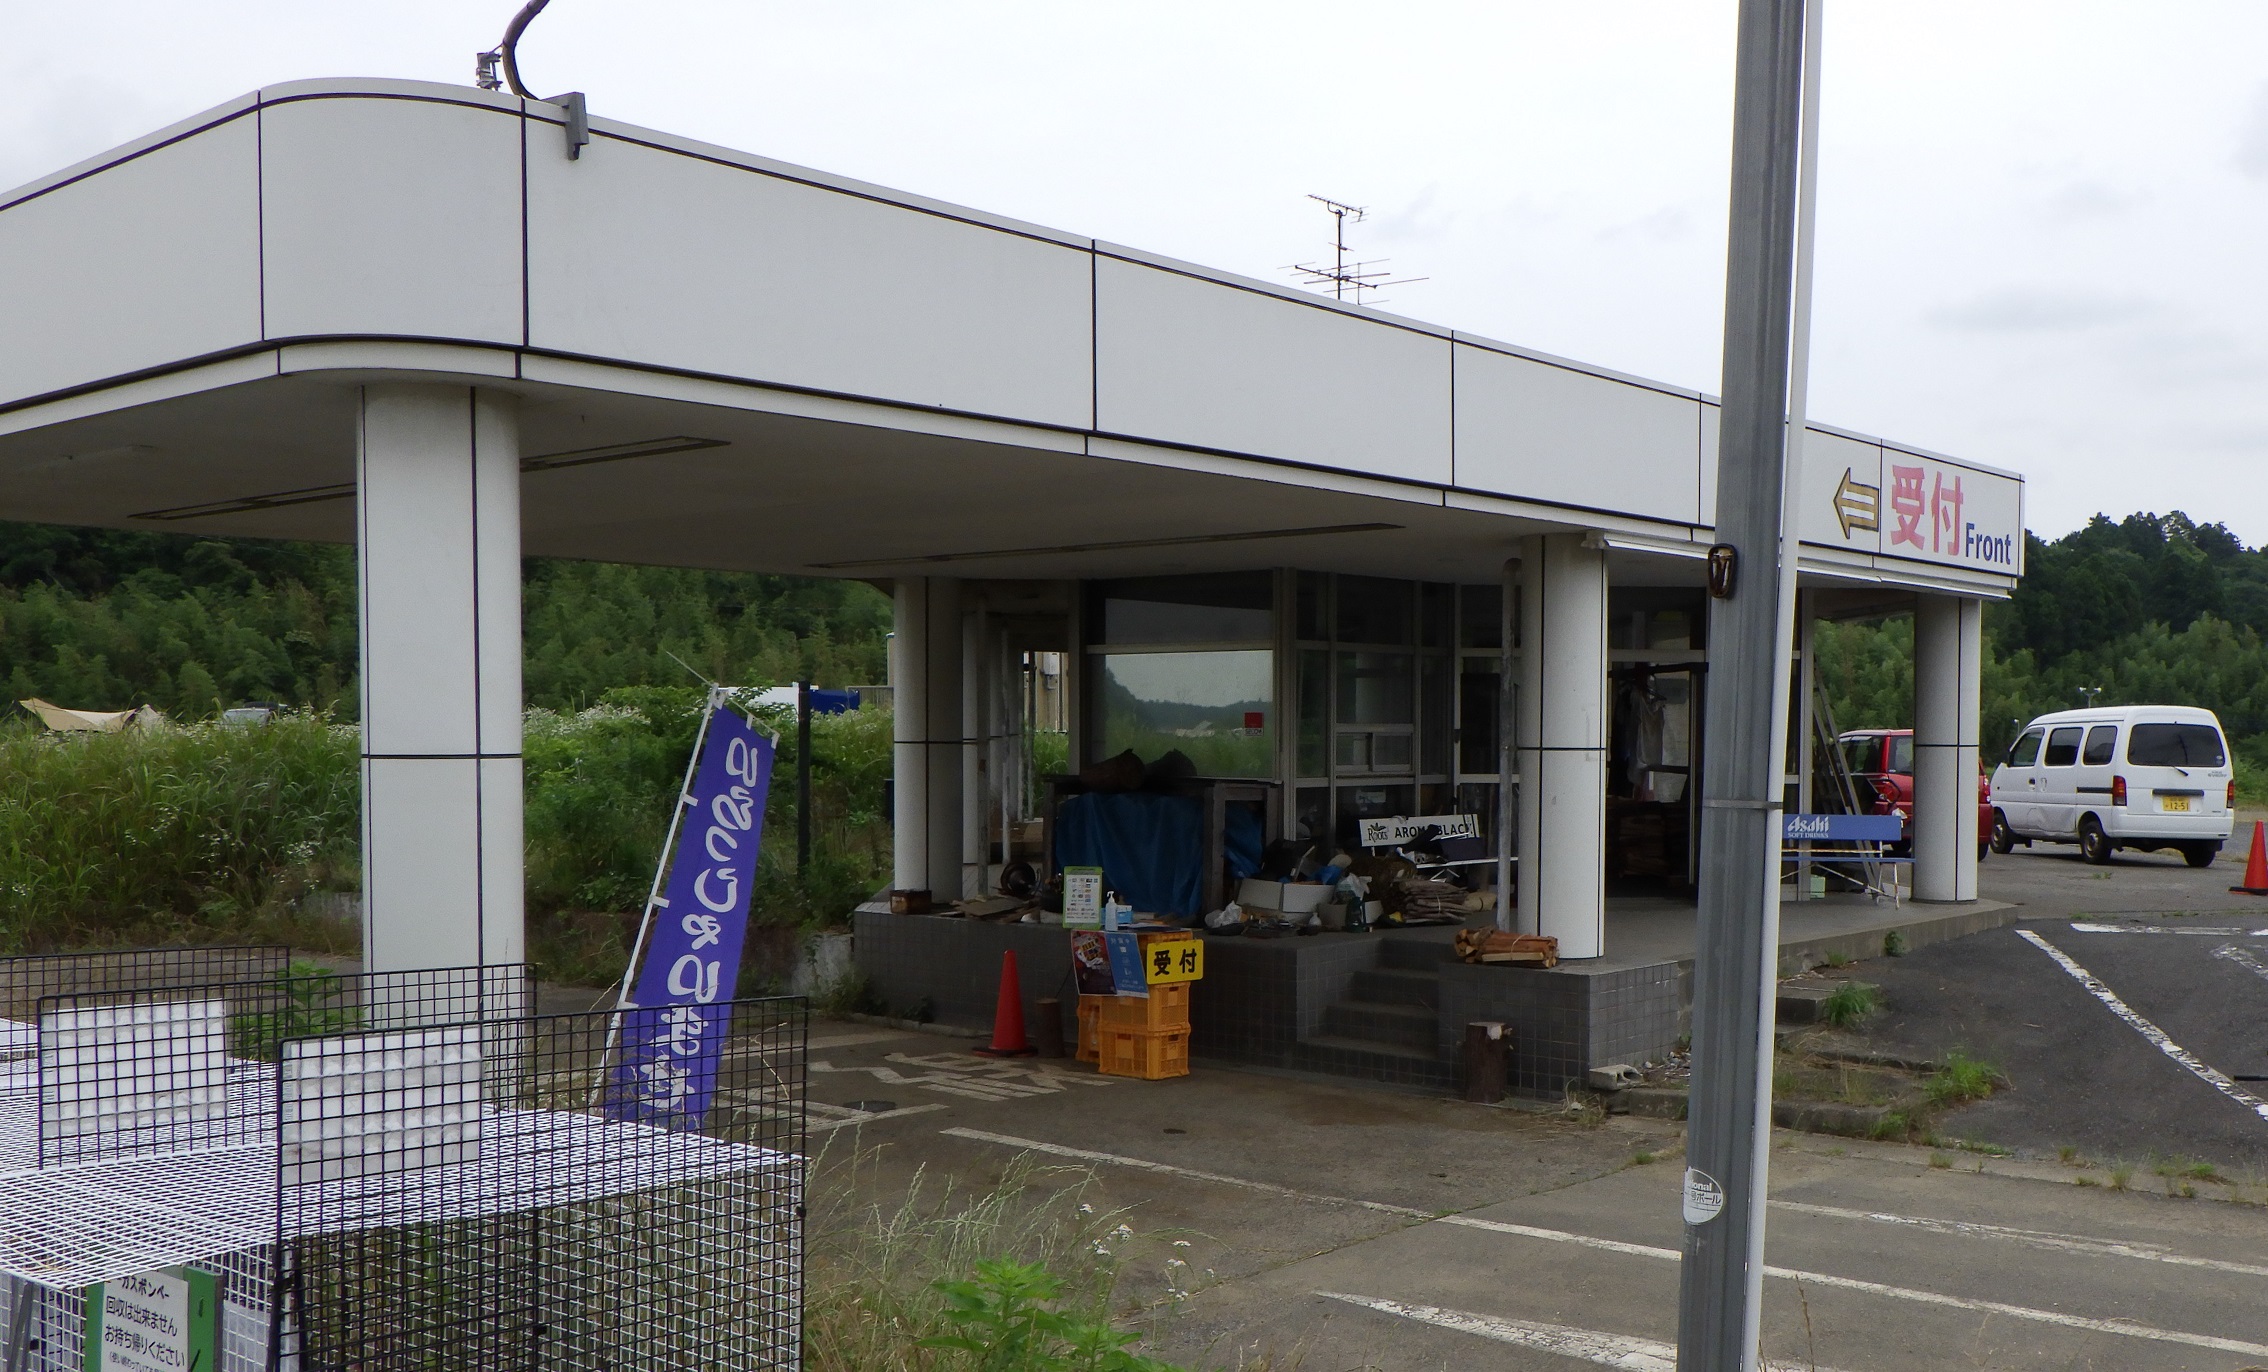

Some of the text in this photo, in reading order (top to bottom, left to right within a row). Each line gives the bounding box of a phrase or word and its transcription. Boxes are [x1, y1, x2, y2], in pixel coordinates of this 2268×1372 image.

[1891, 465, 1963, 556] 受付
[1966, 523, 2011, 565] Front
[1395, 824, 1428, 838] AROM
[1788, 816, 1829, 832] Asahi
[1154, 948, 1197, 976] 受付
[106, 1296, 178, 1337] 回収は出来ません
[105, 1324, 185, 1367] お持ち帰りください
